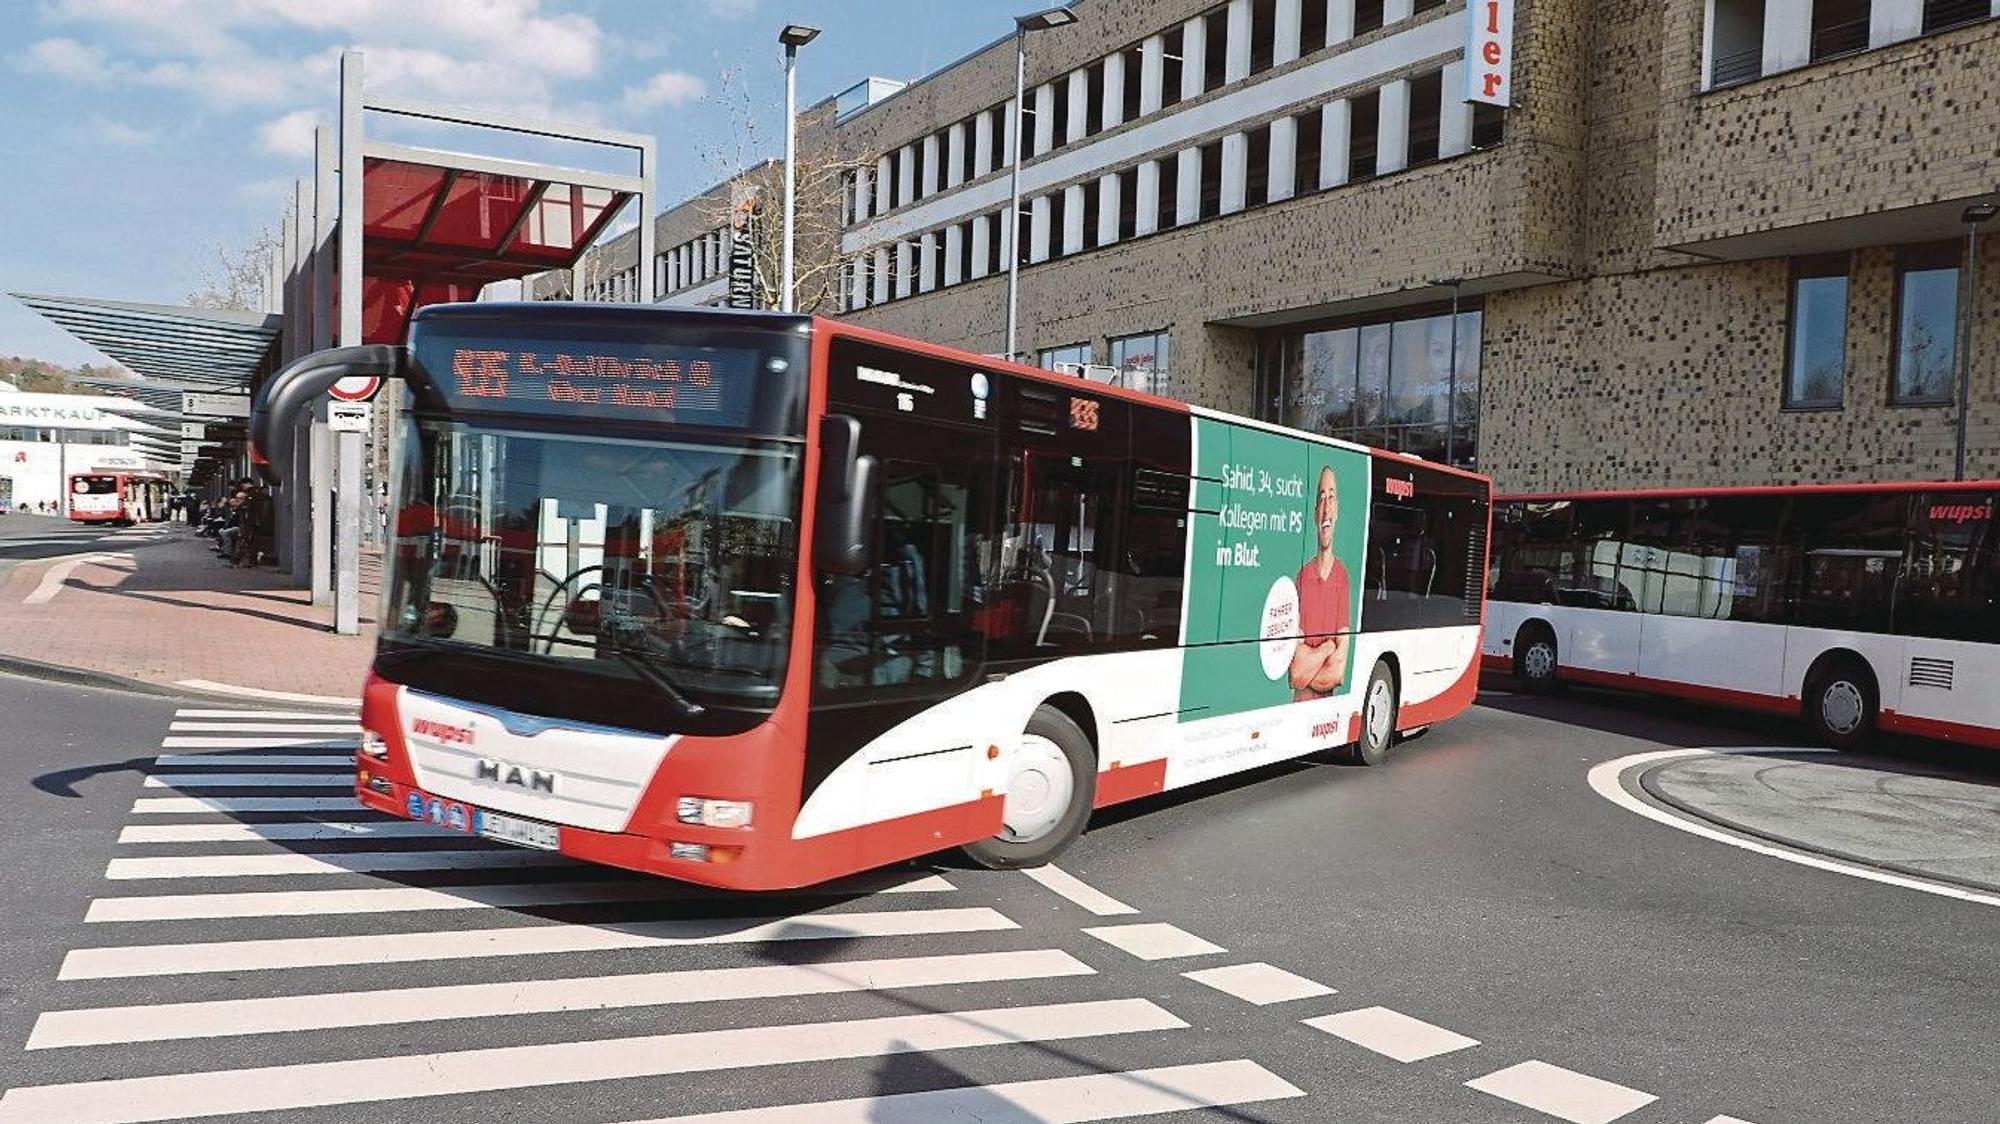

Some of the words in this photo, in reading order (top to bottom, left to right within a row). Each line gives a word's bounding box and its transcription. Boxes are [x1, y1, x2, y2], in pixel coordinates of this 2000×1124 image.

[1222, 464, 1255, 496] Sahid,
[1258, 470, 1273, 498] 34,
[1276, 474, 1304, 498] sucht
[1219, 504, 1267, 536] Kollegen
[1270, 509, 1287, 532] mit
[1289, 511, 1302, 534] PS
[1929, 498, 1992, 524] wupsi
[1216, 540, 1232, 566] im
[1234, 542, 1260, 567] Blut.
[476, 760, 555, 794] MAN
